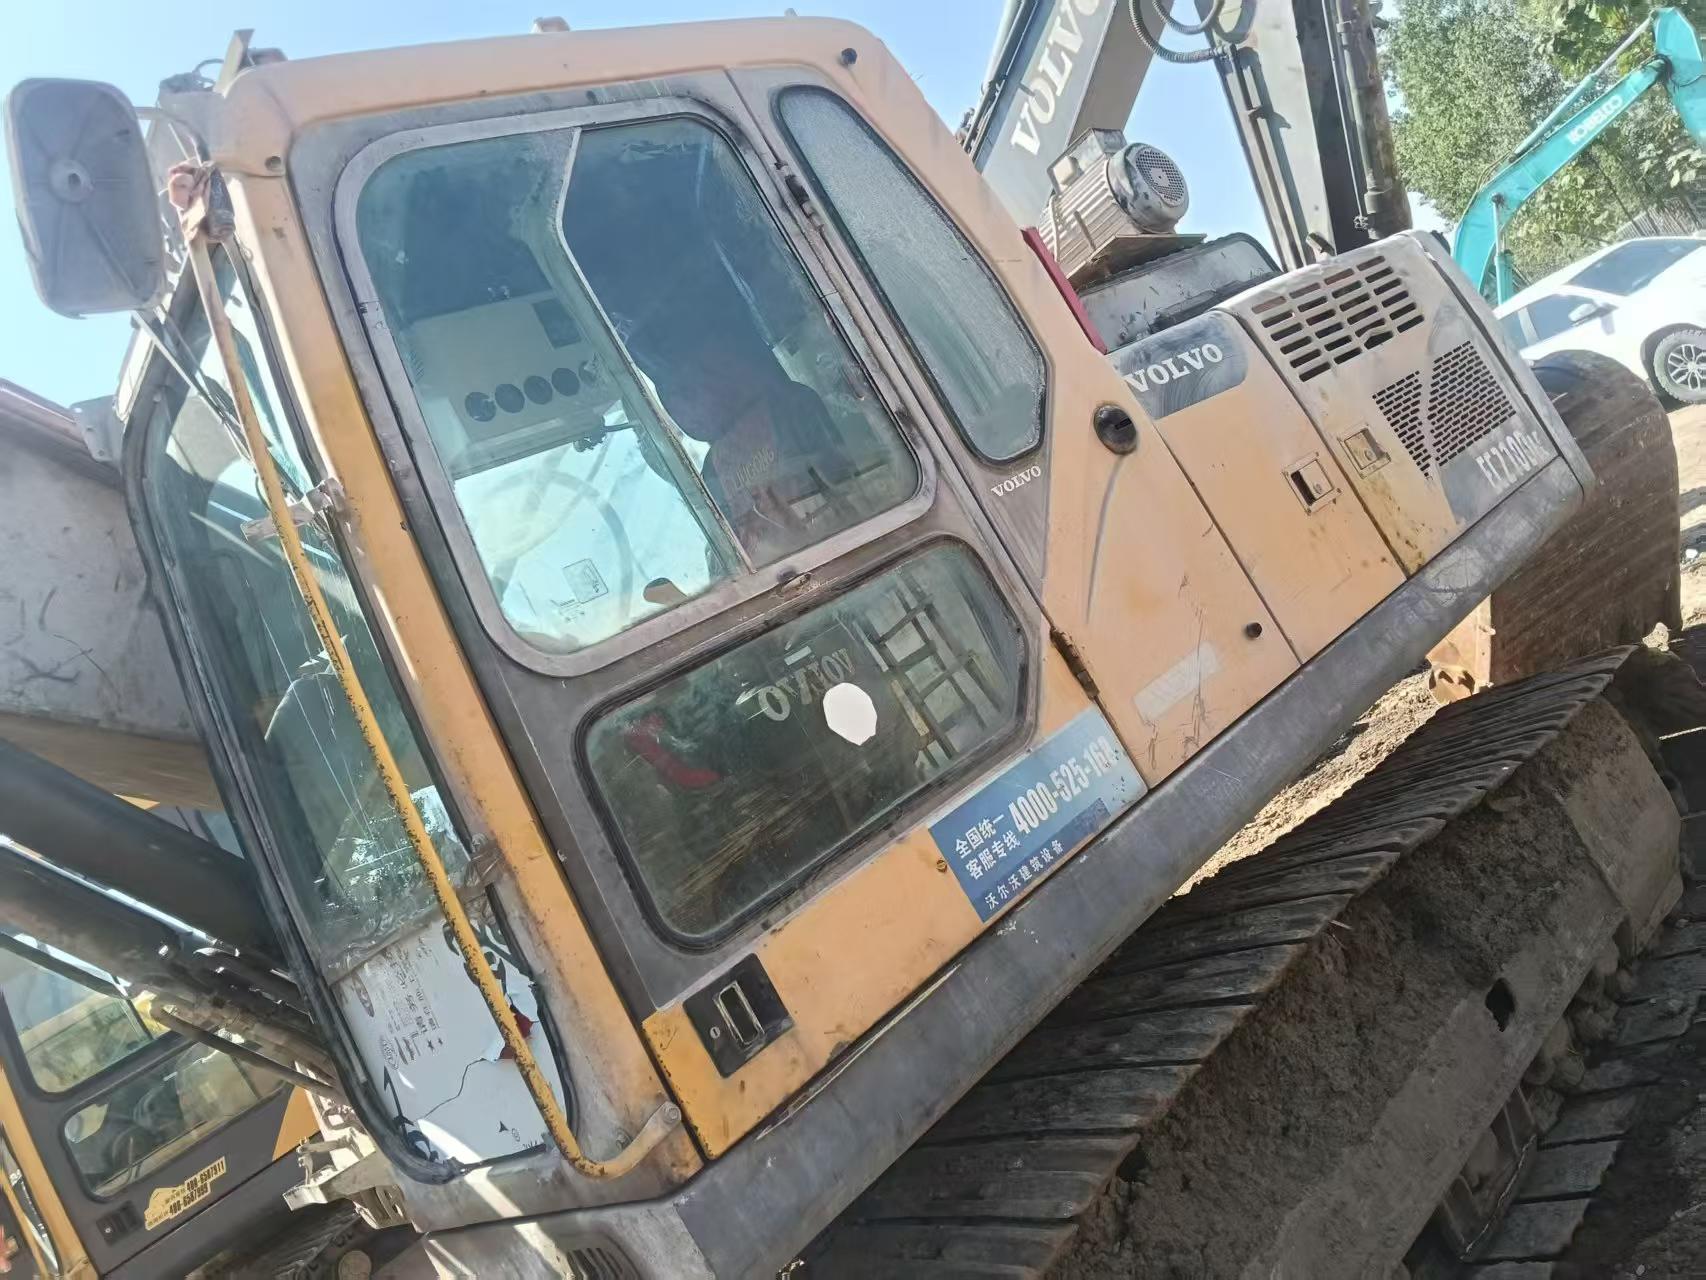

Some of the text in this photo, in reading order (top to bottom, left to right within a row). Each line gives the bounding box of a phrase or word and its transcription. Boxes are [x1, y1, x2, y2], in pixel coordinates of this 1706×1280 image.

[1123, 344, 1223, 393] VOLVO
[991, 466, 1041, 497] VOLVO
[955, 813, 1005, 859] 全国统一
[965, 831, 1021, 880] 客服专线
[985, 839, 1064, 911] 沃尔沃建筑设备
